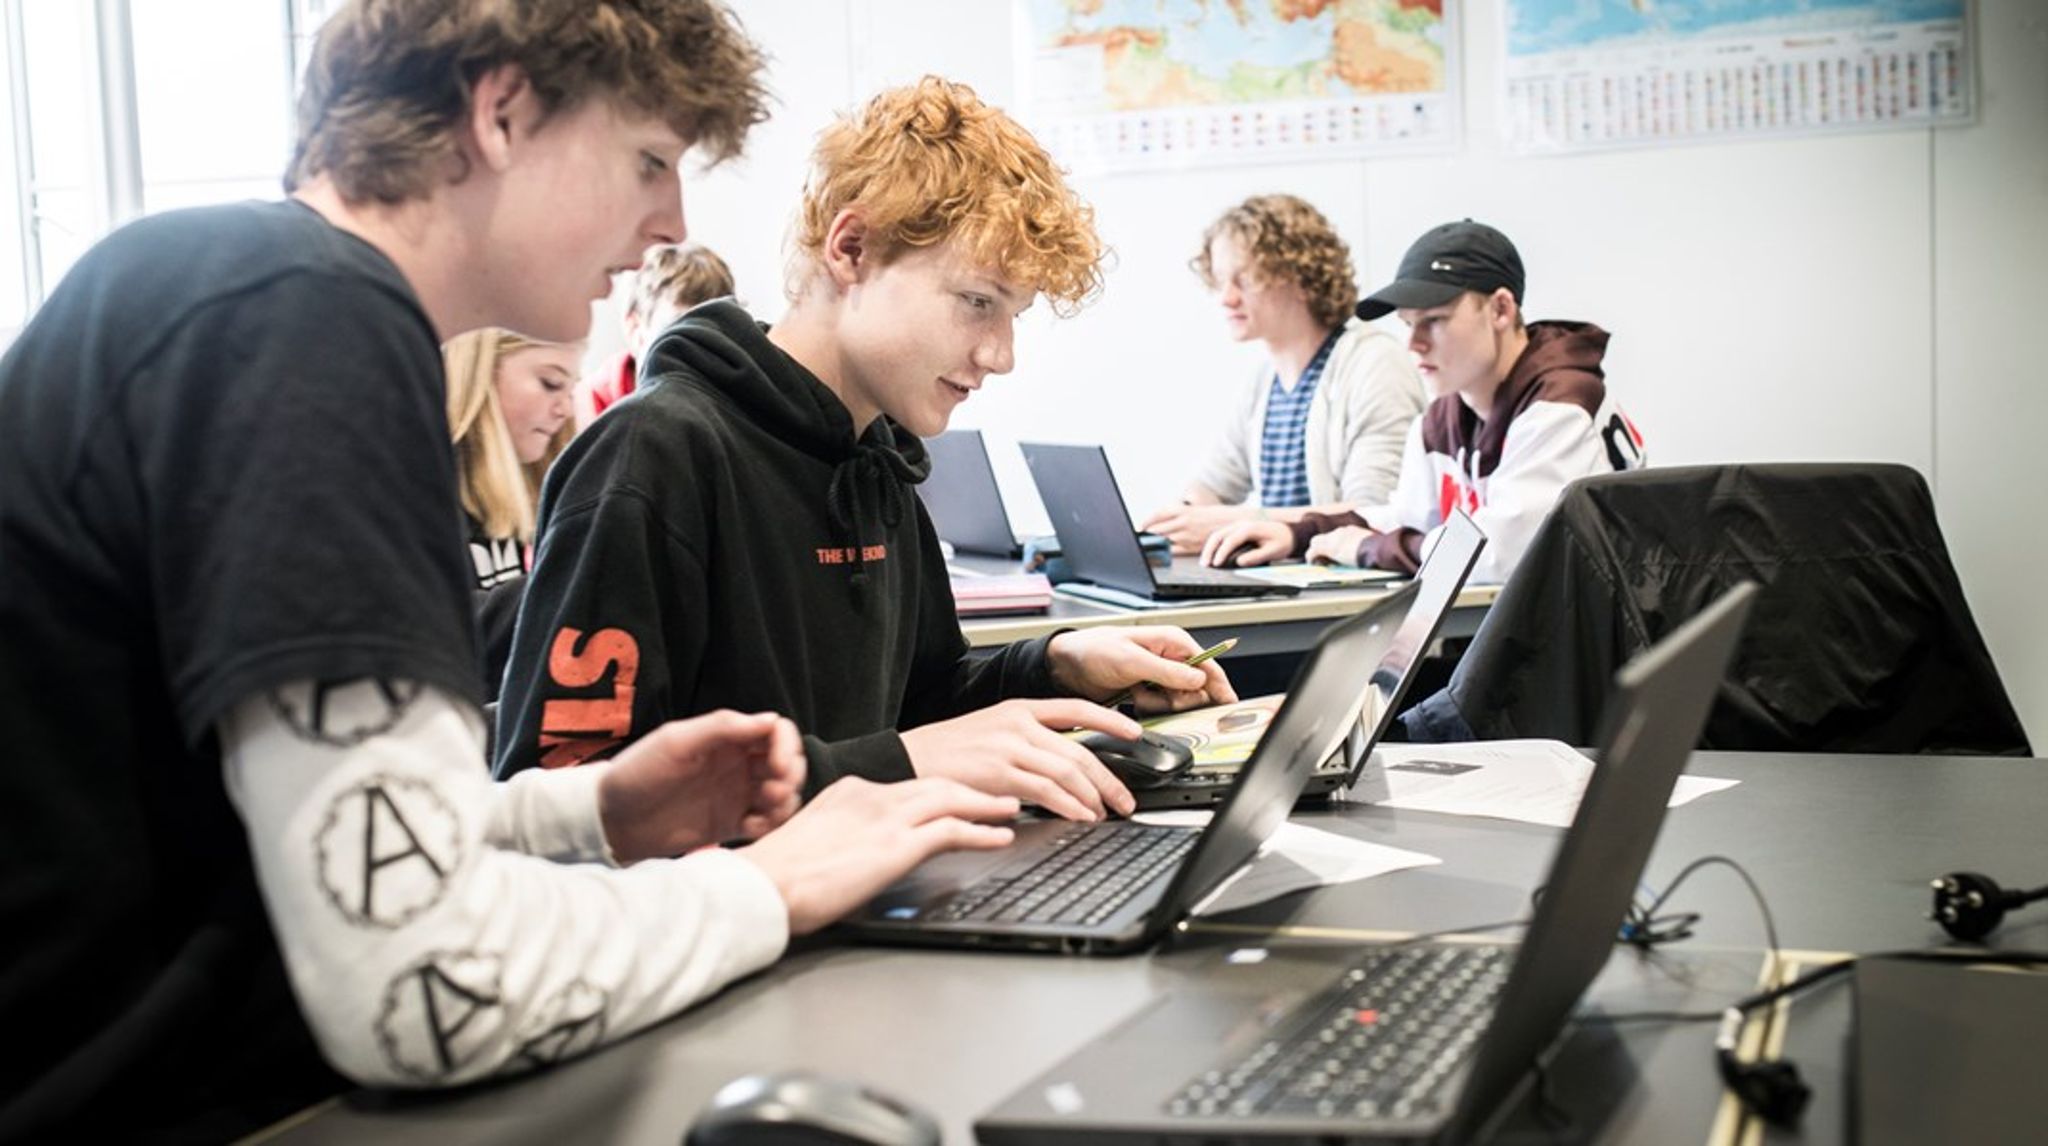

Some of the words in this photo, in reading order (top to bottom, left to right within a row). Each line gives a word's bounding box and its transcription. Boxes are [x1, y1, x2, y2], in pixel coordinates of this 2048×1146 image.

[817, 549, 843, 563] THE
[361, 784, 446, 918] A
[420, 962, 501, 1073] A
